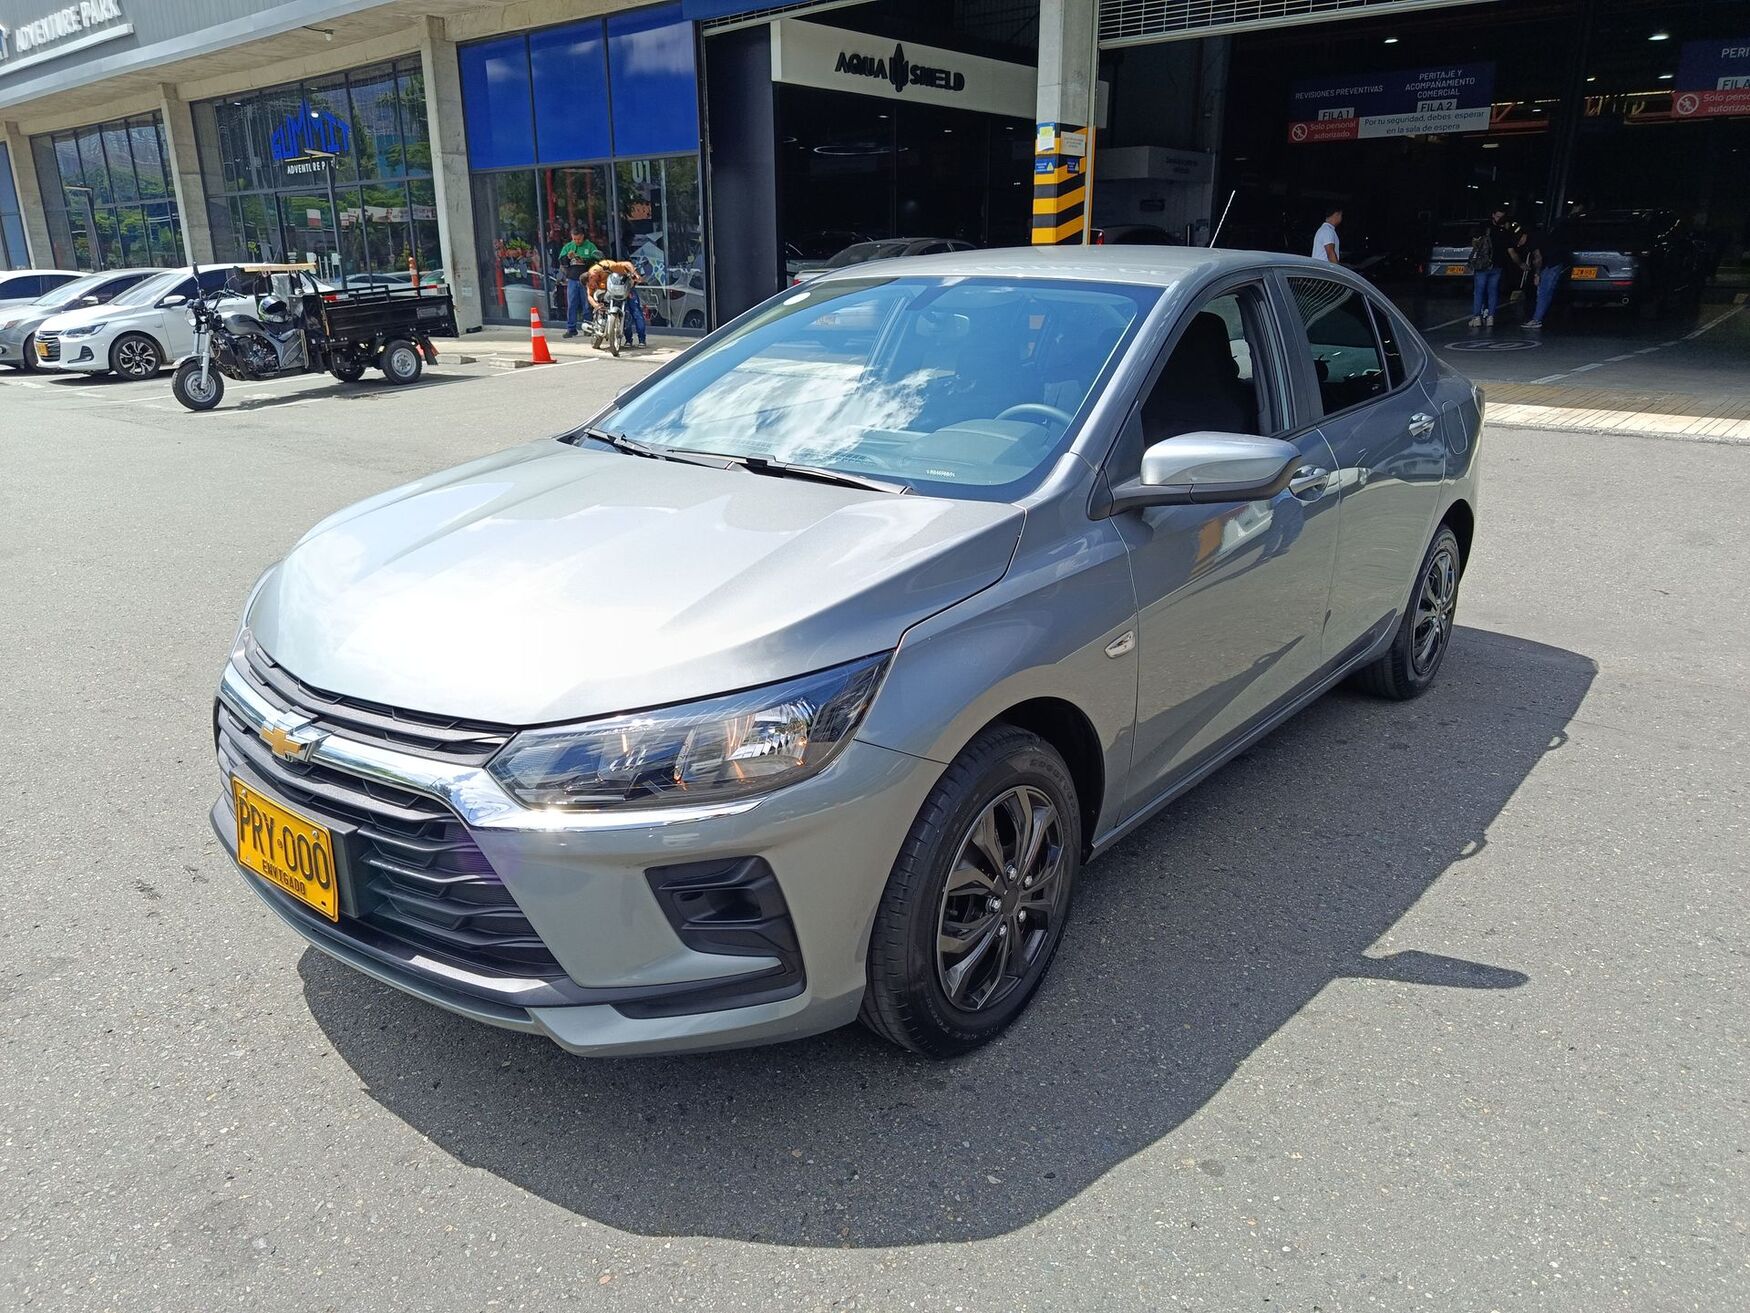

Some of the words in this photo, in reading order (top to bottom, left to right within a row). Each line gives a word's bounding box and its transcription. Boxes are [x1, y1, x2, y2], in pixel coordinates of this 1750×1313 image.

[15, 5, 82, 52] ADVENTURE
[835, 51, 888, 80] AQUA
[909, 64, 965, 91] SHIELD
[1419, 70, 1456, 81] PERITAJE
[1457, 69, 1463, 77] Y
[1405, 77, 1476, 91] ACOMPAÑAMIENTO
[1295, 89, 1335, 100] REVISIONES
[1335, 85, 1384, 96] PREVENTIVAS
[1416, 88, 1461, 99] COMERCIAL
[1420, 102, 1444, 113] FILA
[1446, 101, 1453, 111] 2
[1364, 118, 1376, 126] Por
[1427, 113, 1451, 121] debes
[1454, 110, 1485, 121] esperar
[271, 97, 350, 160] SUMMIT
[1326, 120, 1356, 131] personal
[1386, 127, 1396, 135] en
[1397, 125, 1405, 133] la
[1405, 124, 1421, 133] sala
[1422, 123, 1432, 132] de
[1433, 123, 1461, 132] espera
[1313, 130, 1350, 140] autorizado
[262, 859, 306, 896] ENVIGADO
